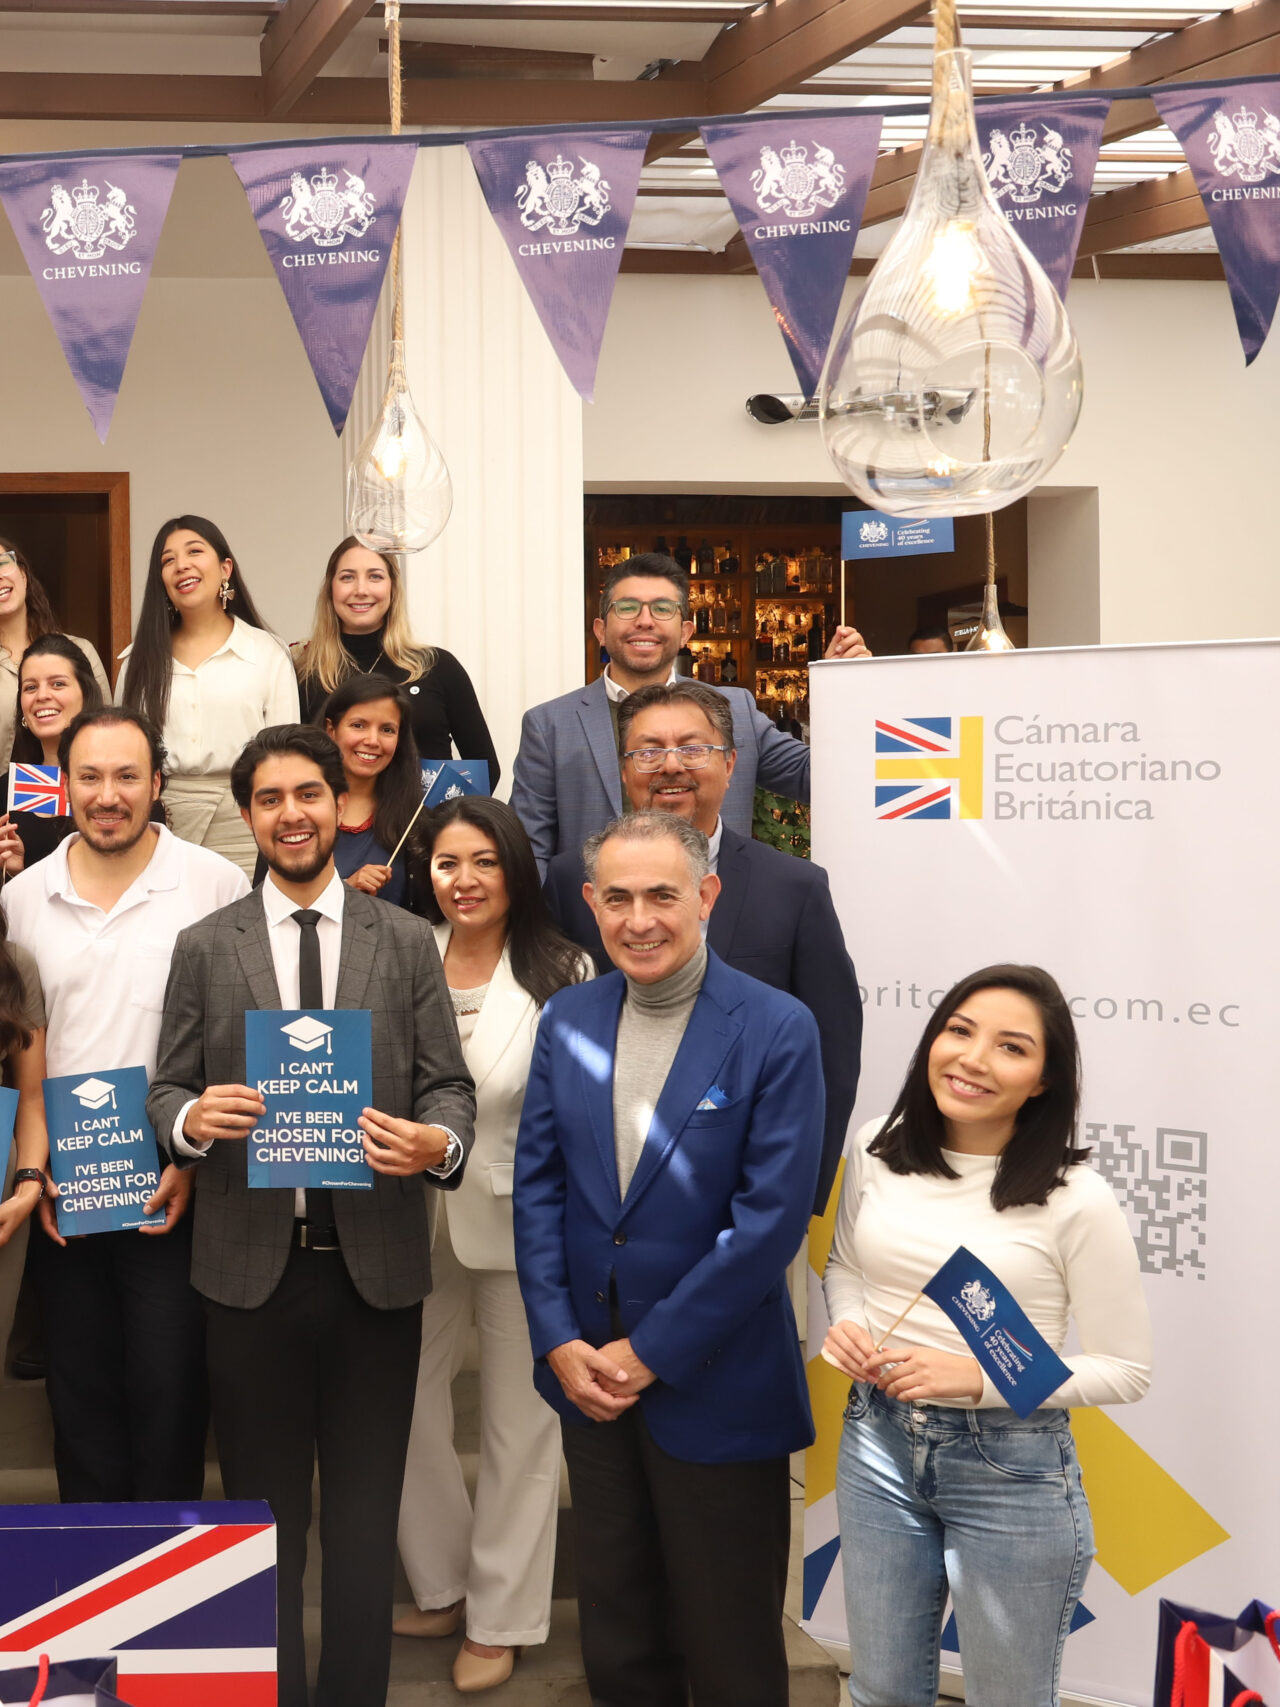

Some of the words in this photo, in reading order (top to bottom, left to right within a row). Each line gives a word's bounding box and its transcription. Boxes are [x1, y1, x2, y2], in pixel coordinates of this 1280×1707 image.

[1007, 204, 1077, 222] EVENING
[754, 220, 850, 240] CHEVENING
[518, 237, 615, 256] CHEVENING
[282, 250, 380, 268] CHEVENING
[43, 262, 141, 280] CHEVENING
[897, 528, 931, 536] Celebrating
[994, 714, 1141, 745] Cámara
[994, 753, 1222, 783] Ecuatoriano
[994, 790, 1155, 821] Británica
[280, 1063, 285, 1075] I
[288, 1062, 334, 1075] CAN'T
[257, 1079, 301, 1095] KEEP
[305, 1079, 359, 1095] CALM
[74, 1121, 79, 1132] I
[81, 1116, 120, 1131] CAN'T
[275, 1111, 302, 1124] I'VE
[305, 1111, 343, 1124] BEEN
[56, 1135, 94, 1152] KEEP
[97, 1128, 144, 1147] CALM
[251, 1128, 326, 1144] CHOSEN
[255, 1147, 365, 1163] CHEVENING!
[75, 1163, 99, 1177] I'VE
[100, 1159, 134, 1174] BEEN
[57, 1175, 121, 1196] CHOSEN
[124, 1171, 157, 1188] FOR
[951, 1296, 980, 1332] CHEVENING
[989, 1335, 999, 1346] 40
[995, 1346, 1013, 1368] years
[994, 1329, 1026, 1373] Celebrating
[989, 1348, 1017, 1387] excellence
